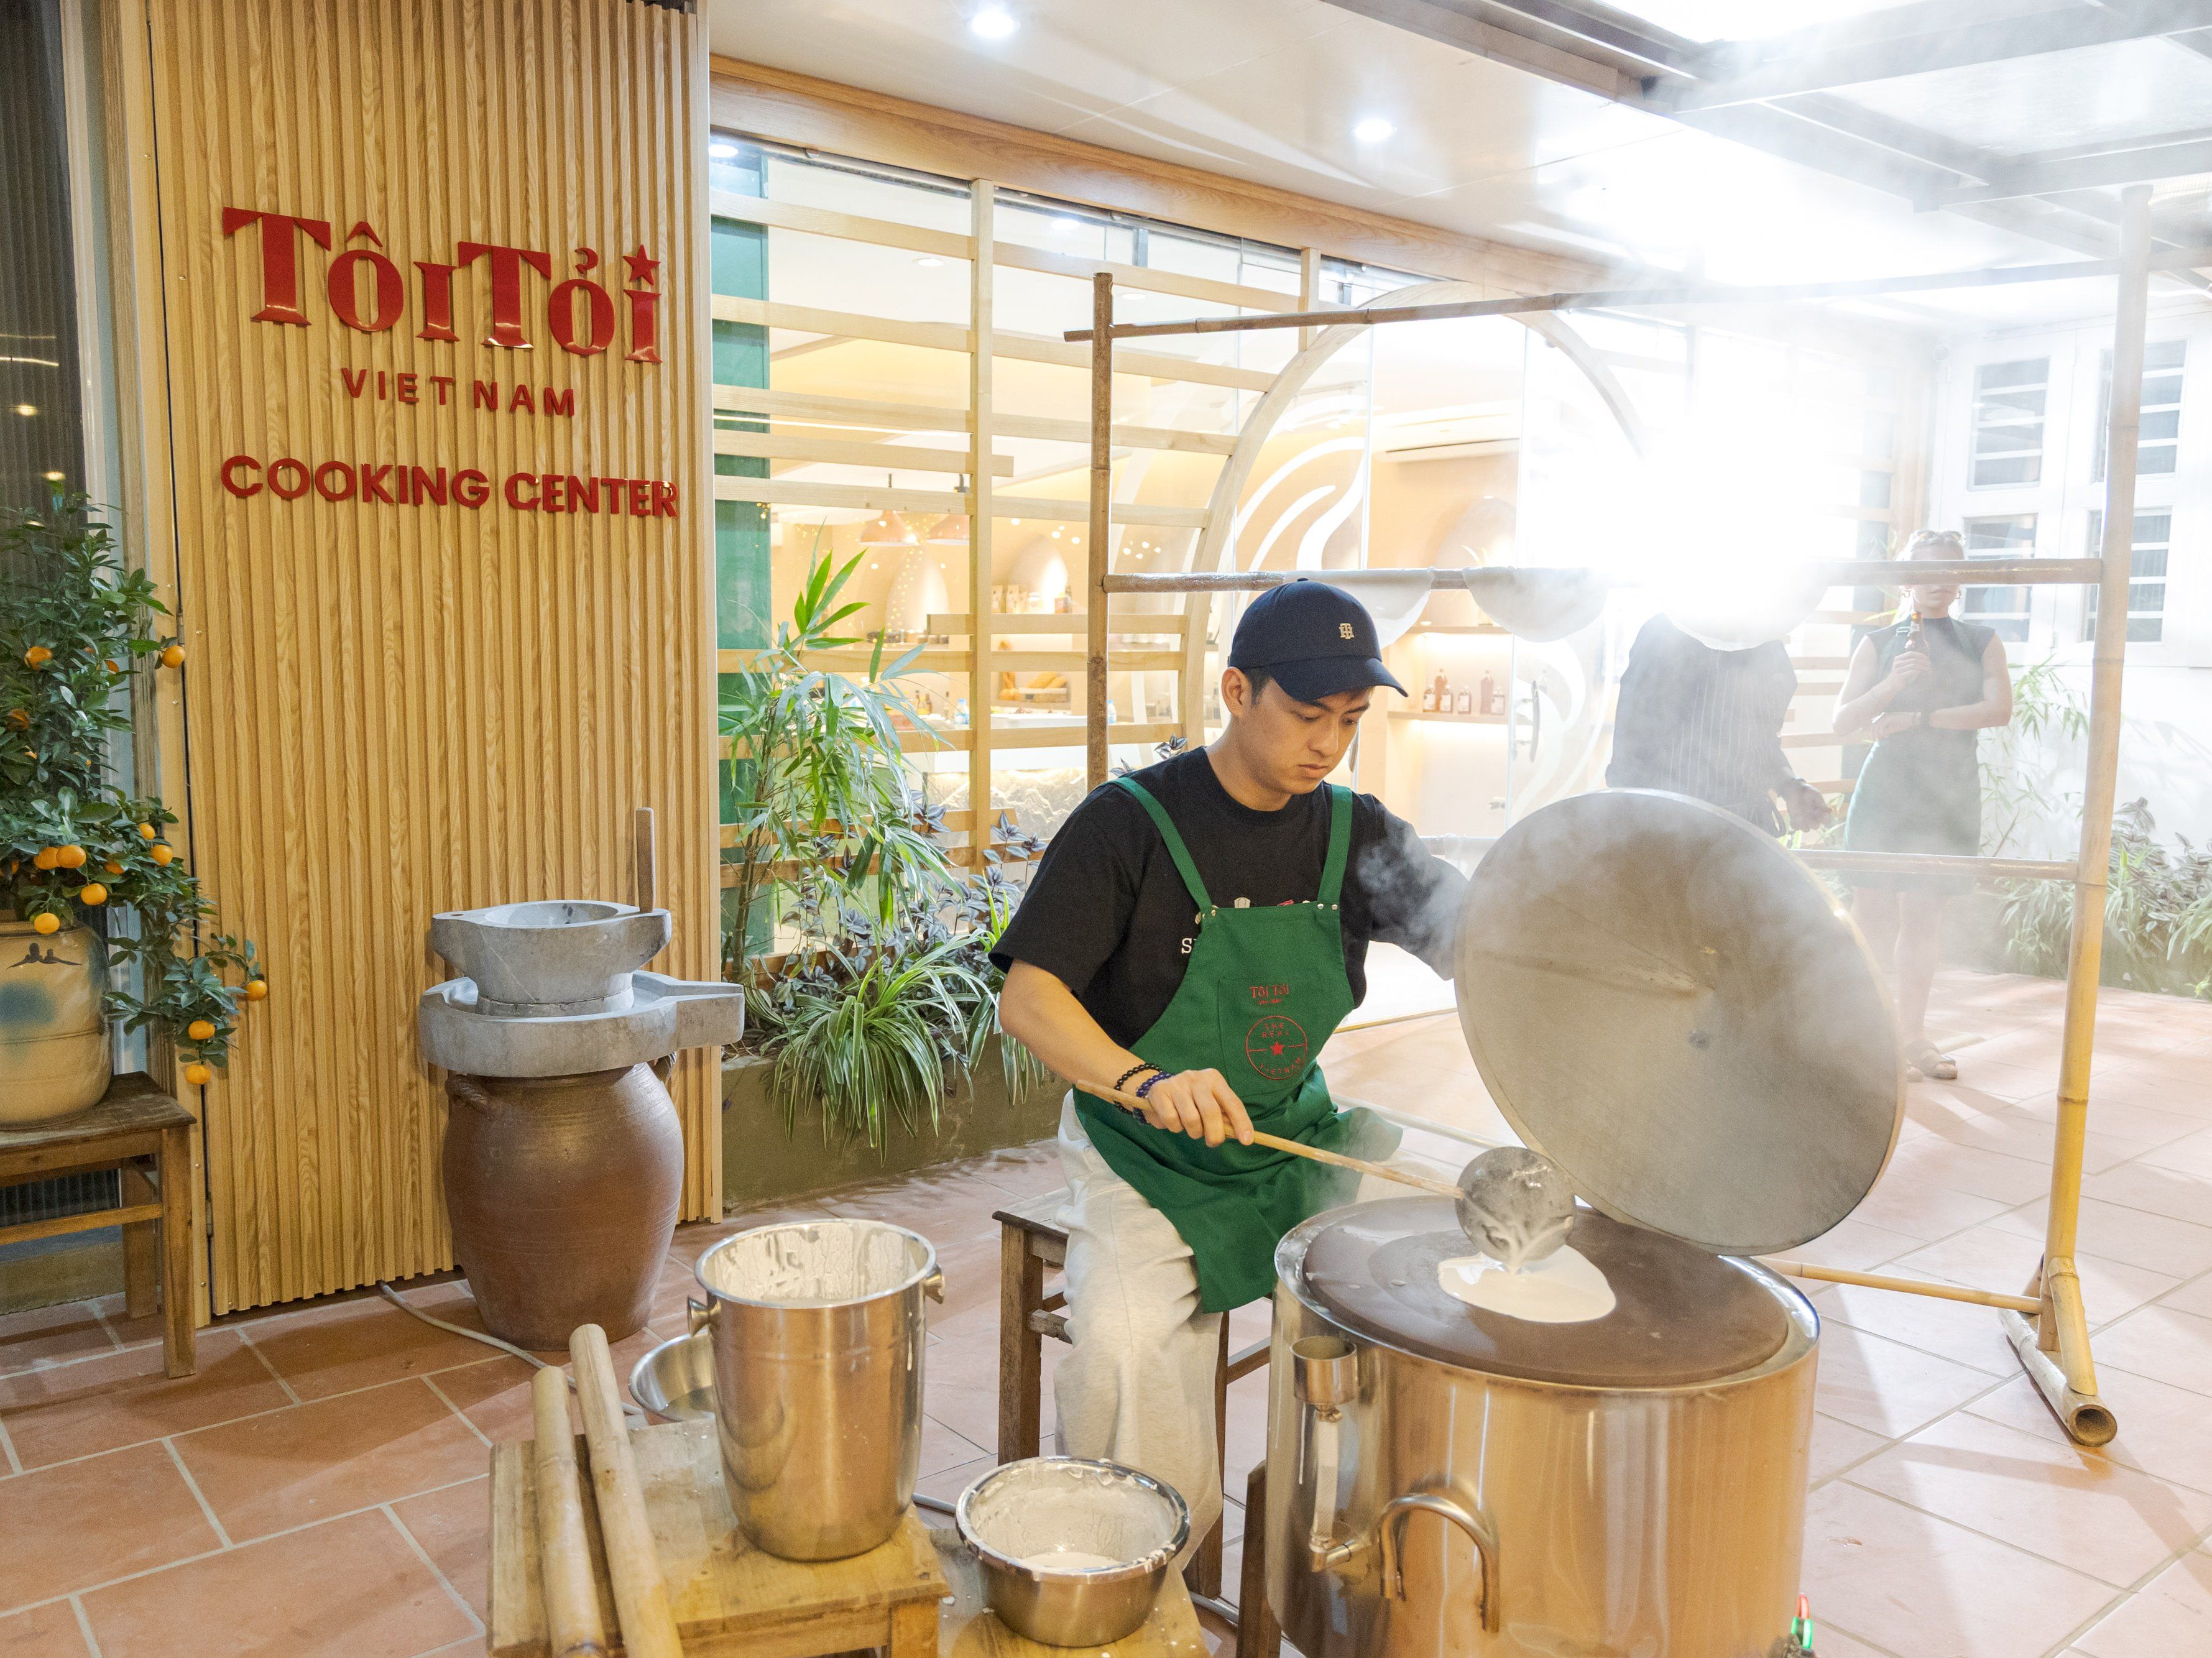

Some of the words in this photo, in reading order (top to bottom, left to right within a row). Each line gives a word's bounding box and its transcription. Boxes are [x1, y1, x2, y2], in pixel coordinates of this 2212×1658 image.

[341, 367, 454, 406] VIET
[473, 379, 575, 417] NAM
[220, 454, 491, 509] COOKING
[504, 472, 680, 518] CENTER
